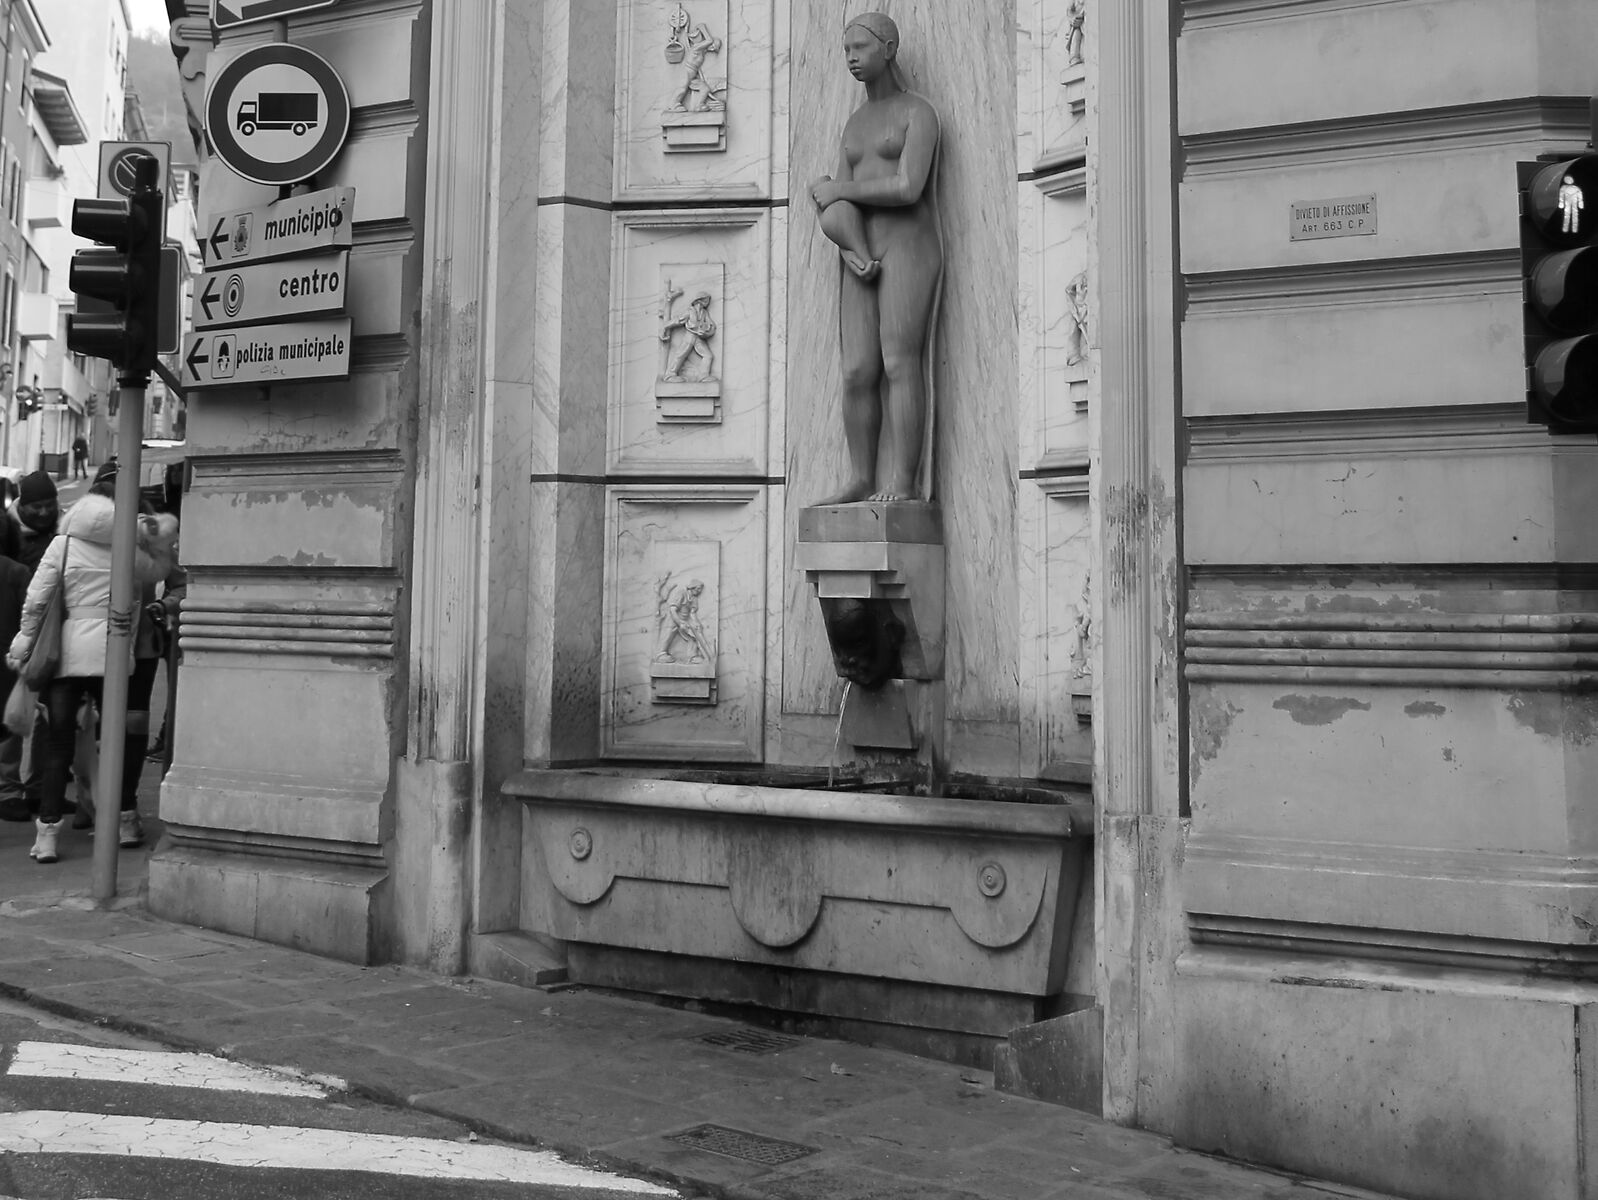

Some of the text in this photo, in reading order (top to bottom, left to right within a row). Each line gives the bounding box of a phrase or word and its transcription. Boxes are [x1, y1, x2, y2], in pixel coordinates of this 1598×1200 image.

[265, 203, 343, 240] municipio
[1295, 202, 1370, 220] DIVIETO DI AFFISSIONE
[1323, 221, 1342, 231] 663
[279, 269, 340, 298] centro
[236, 334, 344, 369] polizia municipale
